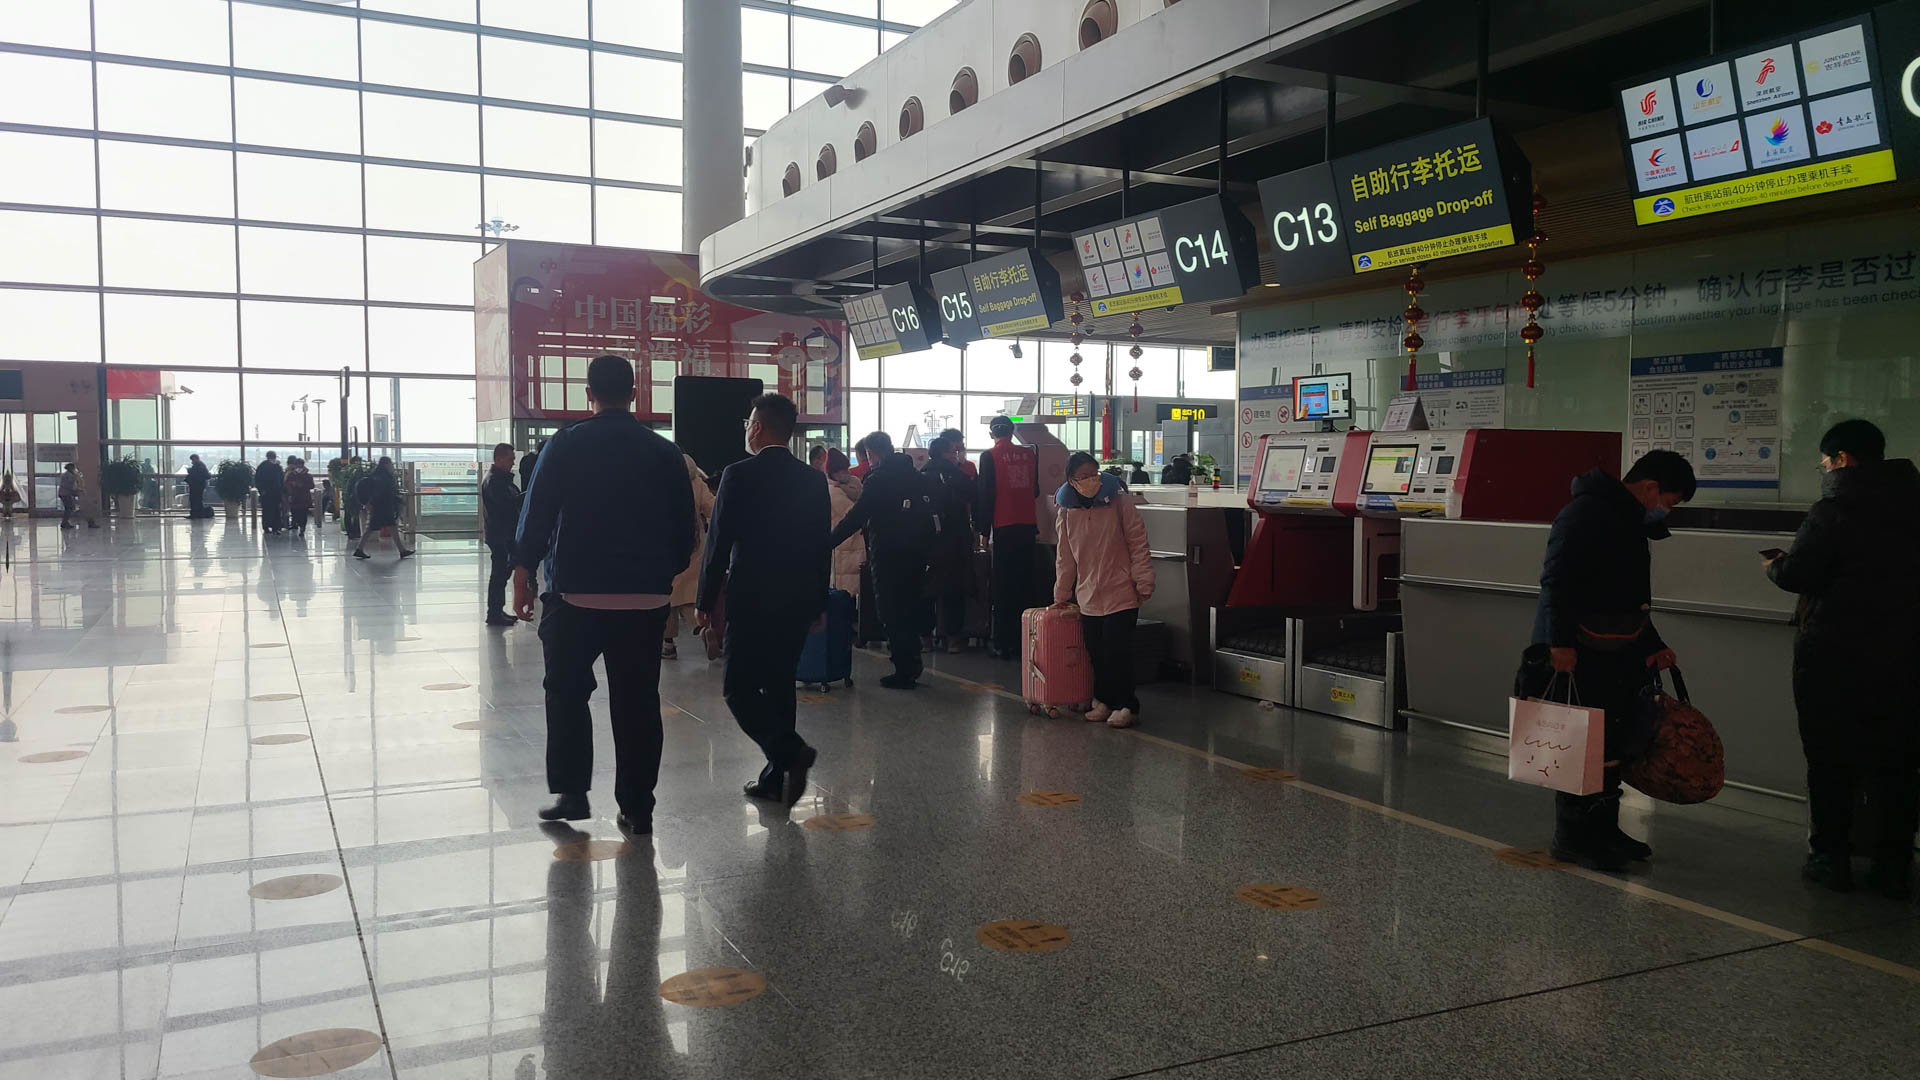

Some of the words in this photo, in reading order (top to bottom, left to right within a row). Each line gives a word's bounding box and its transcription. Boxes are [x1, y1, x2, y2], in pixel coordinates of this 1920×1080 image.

[1350, 143, 1483, 202] 自助行李托运
[1273, 202, 1338, 252] C13
[1355, 217, 1378, 234] Self
[1381, 206, 1434, 228] Baggage
[1437, 190, 1494, 217] Drop-off
[1175, 229, 1230, 273] C14
[973, 264, 1030, 294] 自助行李托运
[575, 294, 713, 334] 中国福彩
[892, 305, 920, 333] C16
[941, 291, 973, 322] C15
[990, 299, 1013, 311] Baggage
[1013, 292, 1037, 306] Drop-off
[1559, 322, 1588, 334] check
[1633, 313, 1676, 326] confirm
[1679, 308, 1725, 322] whether
[1729, 306, 1755, 320] your
[1816, 295, 1838, 308] has
[1843, 290, 1878, 304] been
[1193, 408, 1206, 421] 10
